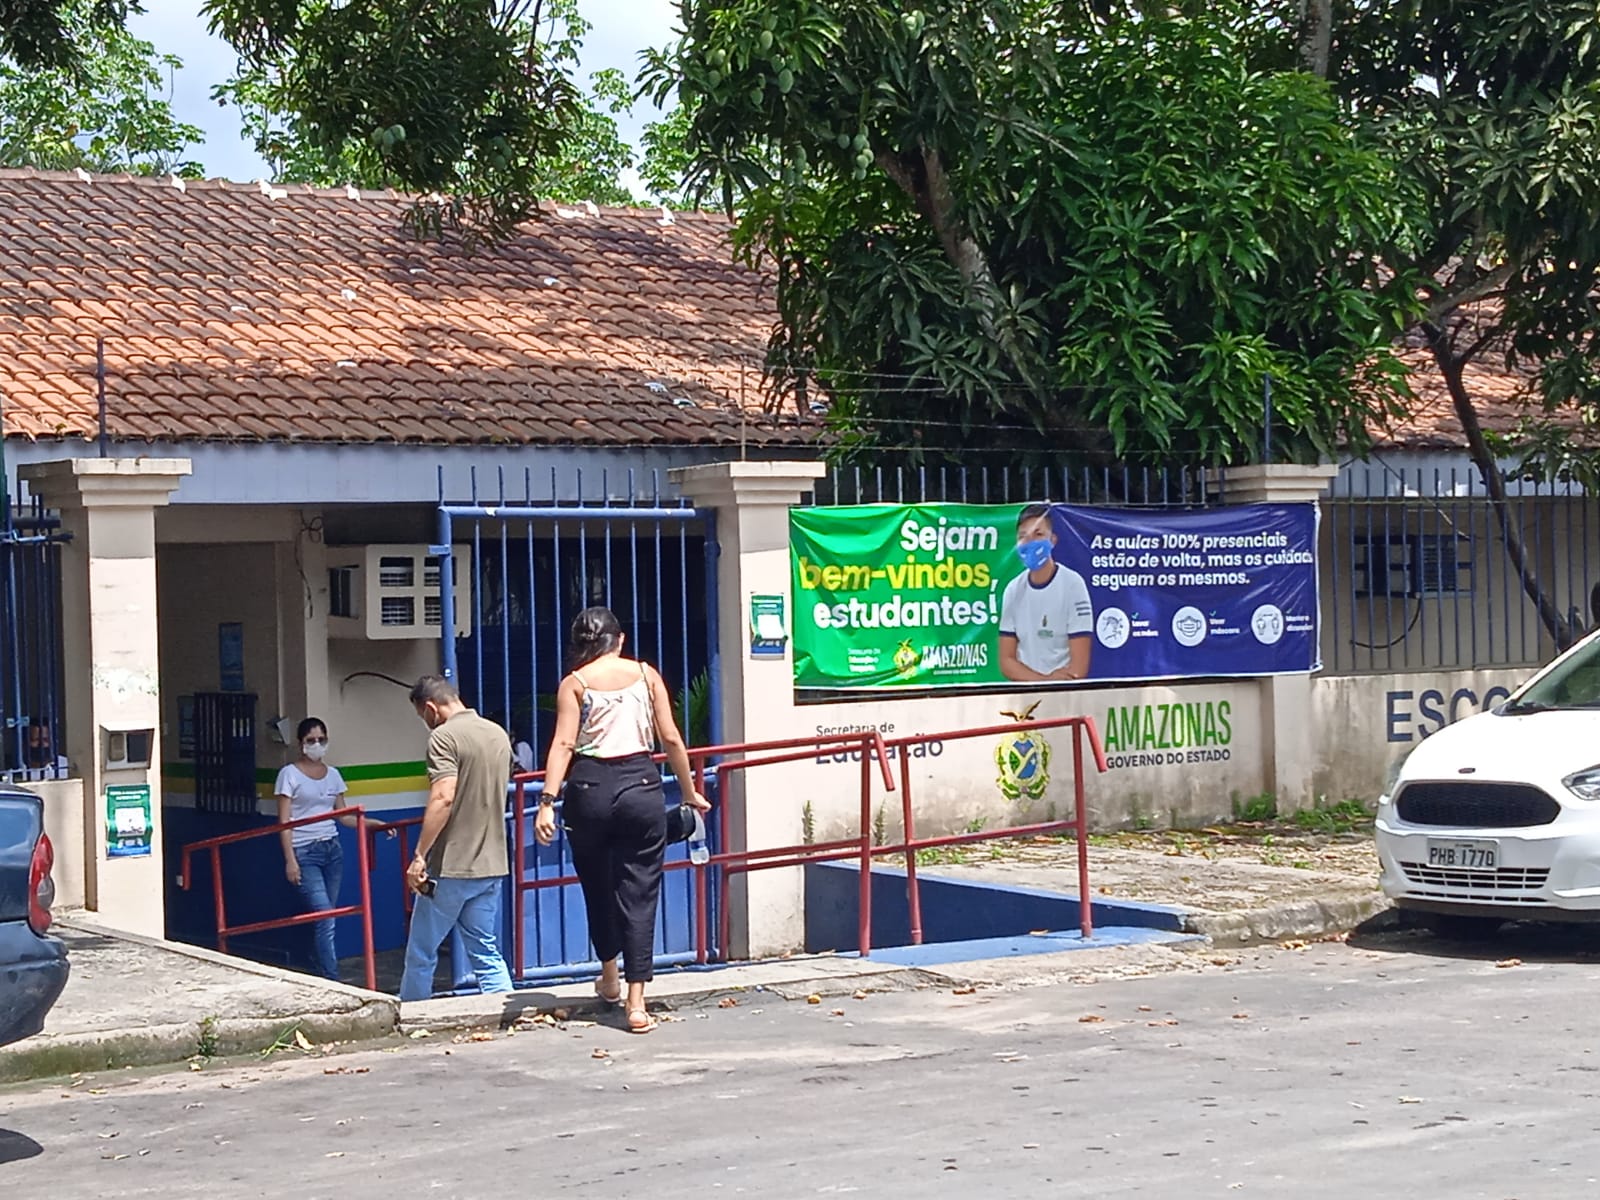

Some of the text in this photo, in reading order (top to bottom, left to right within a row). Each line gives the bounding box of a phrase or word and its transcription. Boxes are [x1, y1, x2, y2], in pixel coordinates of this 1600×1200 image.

[900, 517, 997, 561] Sejam
[1091, 531, 1288, 552] As aulas 100% presenciais
[1092, 553, 1136, 568] estão
[1138, 552, 1159, 568] de
[1161, 552, 1206, 569] volta,
[1208, 553, 1242, 567] mas
[1244, 554, 1262, 566] os
[800, 555, 998, 592] bem-vindos,
[1092, 571, 1250, 591] seguem os mesmos.
[813, 594, 998, 628] estudantes!
[920, 643, 988, 669] AMAZONAS
[816, 722, 895, 737] Secretaria de
[1104, 700, 1232, 753] AMAZONAS
[1106, 748, 1231, 769] GOVERNO DO ESTADO
